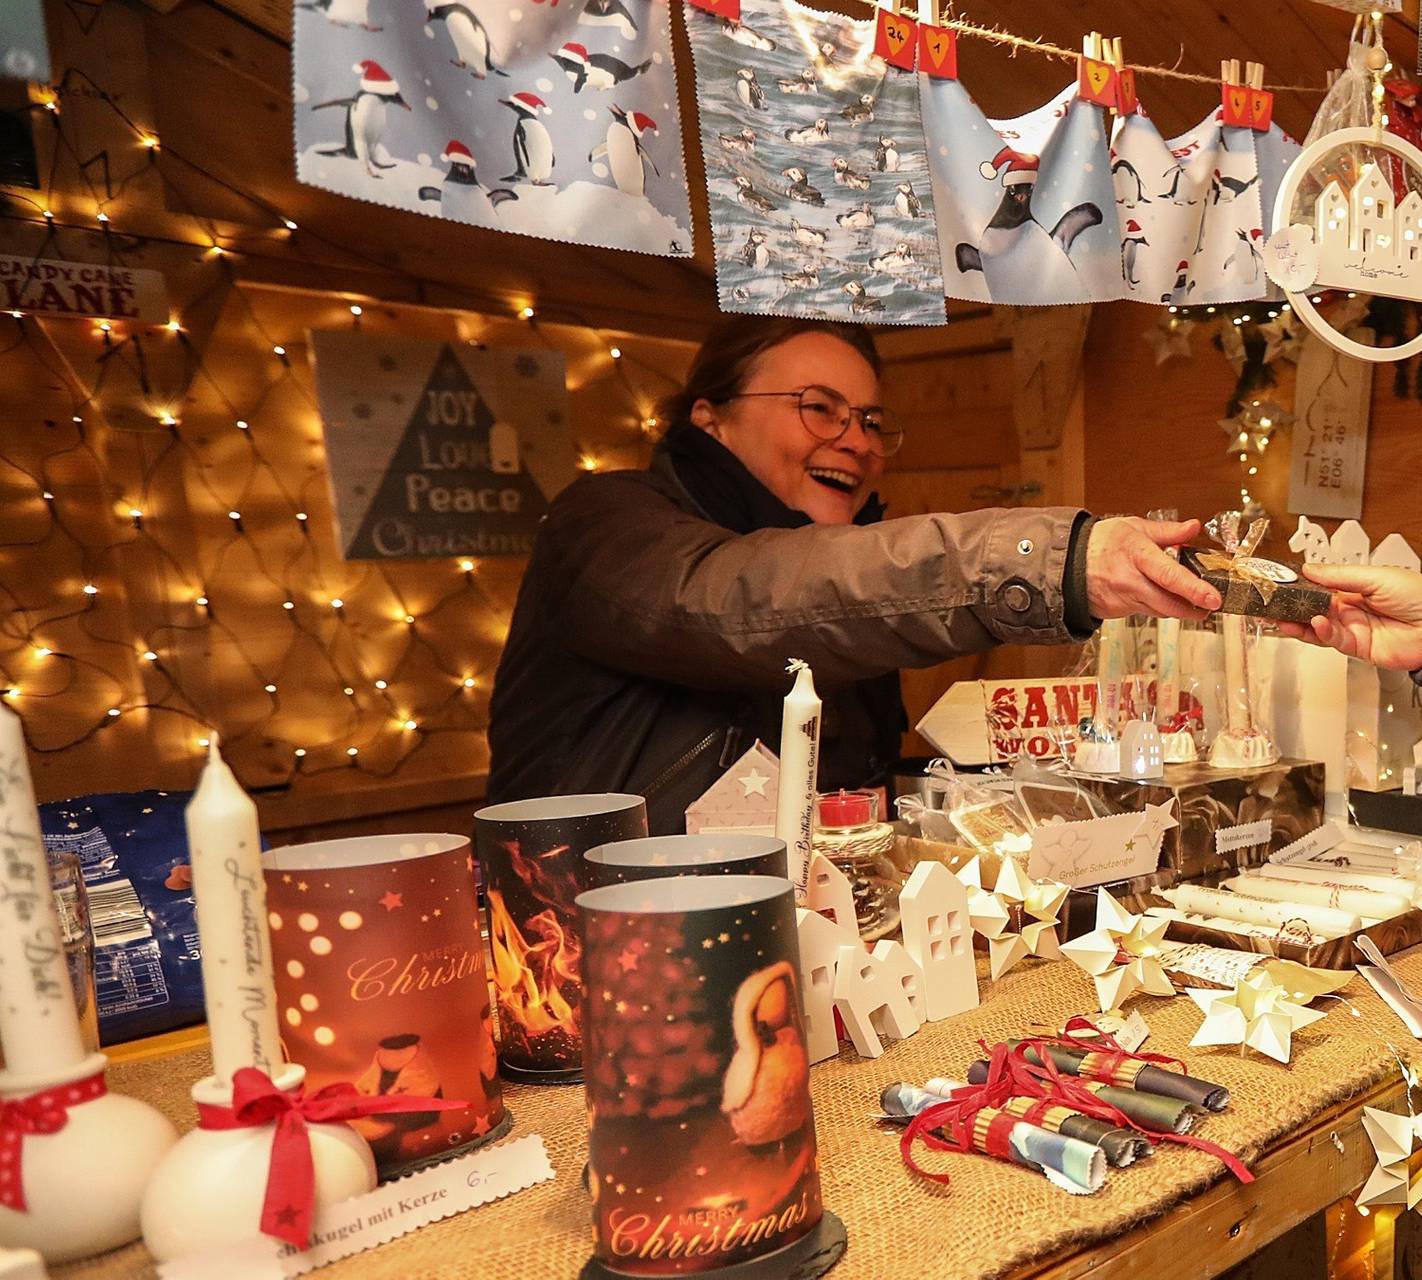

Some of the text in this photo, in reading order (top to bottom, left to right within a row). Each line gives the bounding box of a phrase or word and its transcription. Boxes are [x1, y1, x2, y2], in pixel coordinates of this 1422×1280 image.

[887, 26, 905, 43] 24
[1254, 100, 1261, 112] 5
[0, 260, 134, 286] CANDY CANE
[0, 277, 140, 318] LANE
[406, 472, 521, 513] Peace
[1059, 866, 1088, 880] Großer
[347, 951, 483, 1001] Christm
[237, 983, 272, 1077] Moment
[366, 1207, 394, 1226] mit
[397, 1186, 448, 1216] Kerze
[609, 1191, 808, 1260] Christmas
[678, 1204, 739, 1226] MERRY
